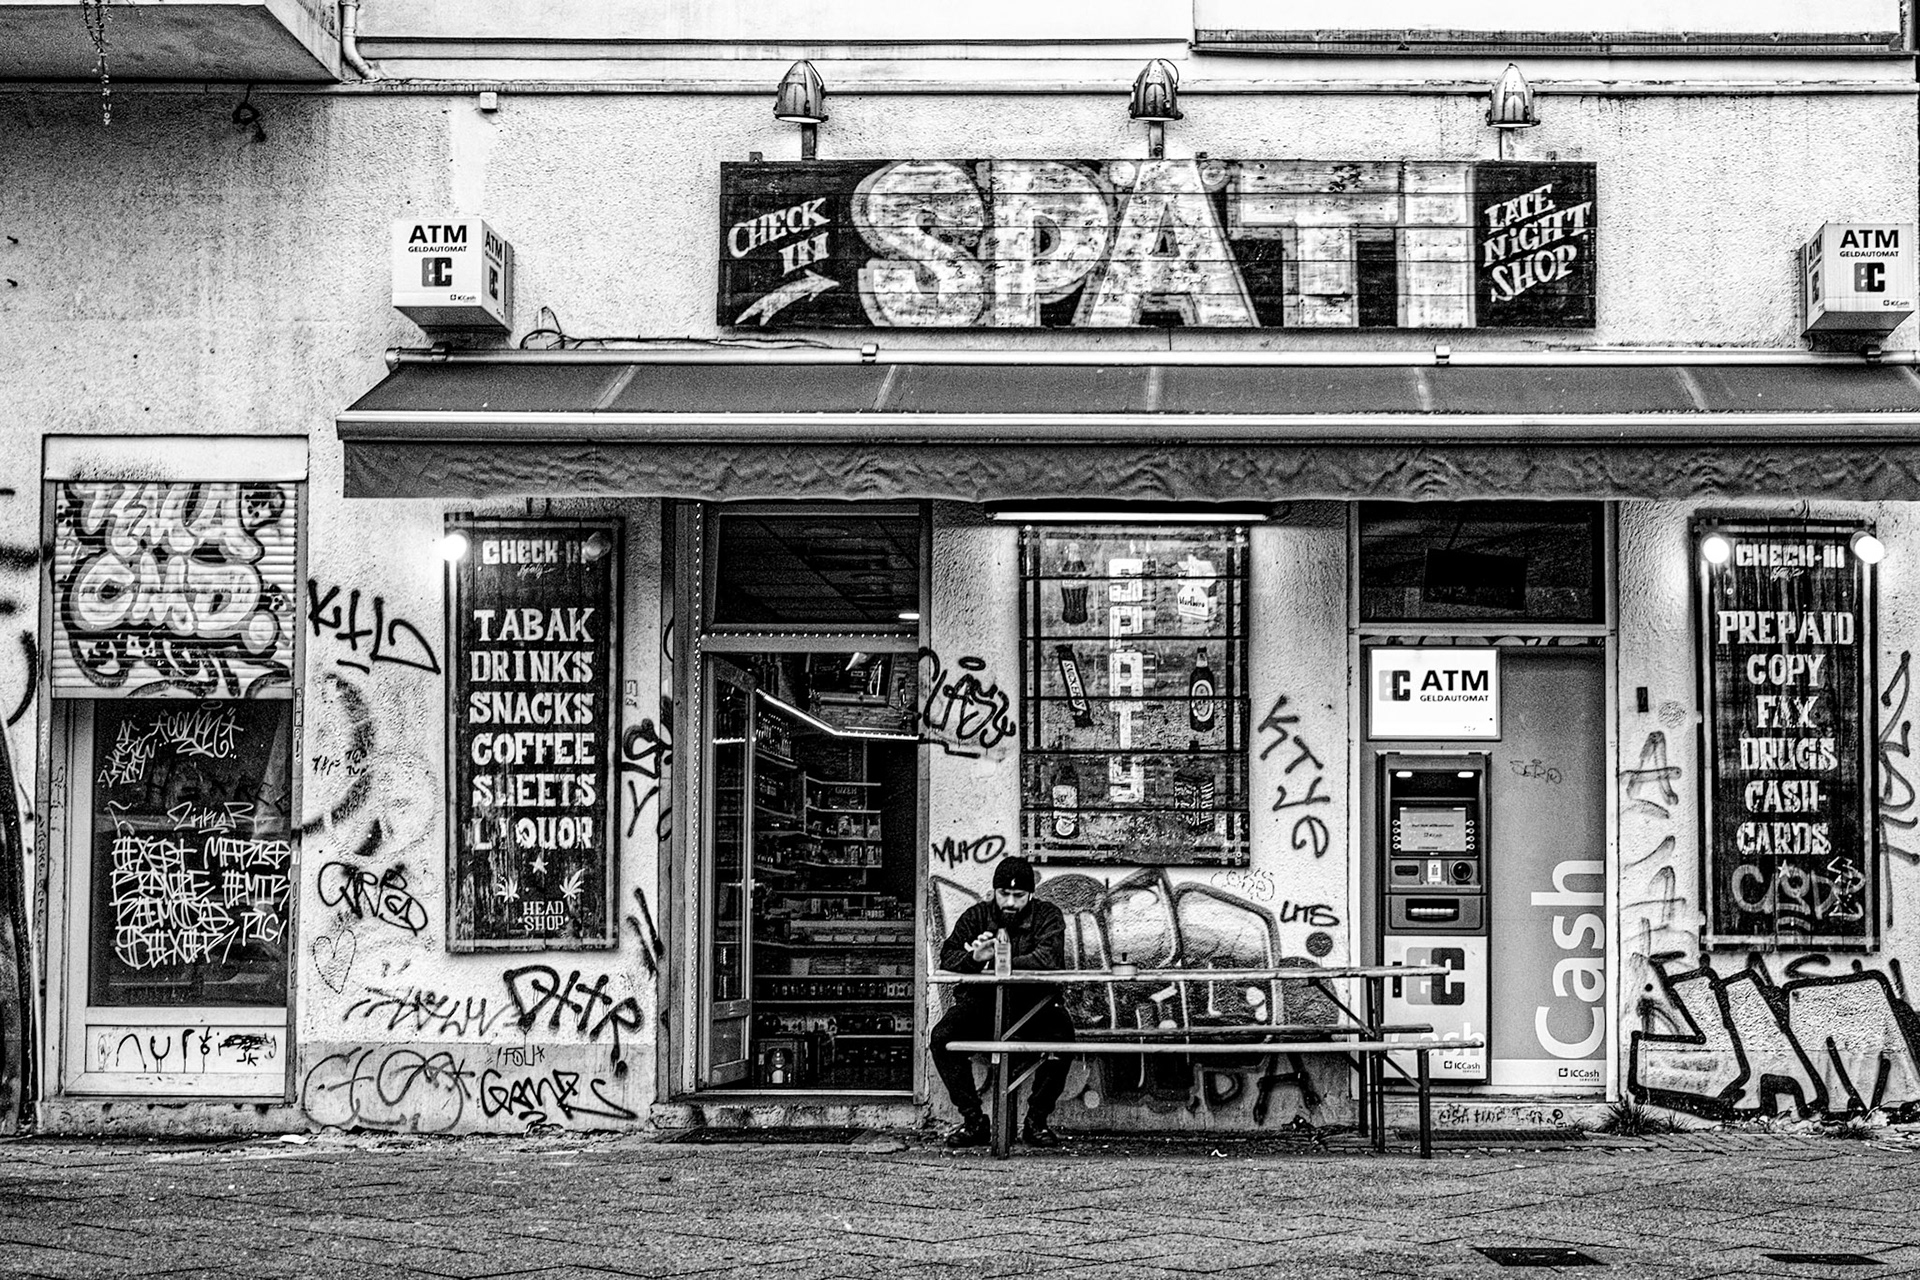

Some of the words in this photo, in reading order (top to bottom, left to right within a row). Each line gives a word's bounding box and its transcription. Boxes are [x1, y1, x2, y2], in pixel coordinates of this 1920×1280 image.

[1484, 183, 1554, 235] LATE
[408, 224, 467, 243] ATM
[727, 198, 831, 258] CHECK
[1839, 229, 1899, 248] ATM
[408, 245, 467, 253] GELDAUTOMAT
[779, 231, 829, 277] IN
[1839, 250, 1899, 258] GELDAUTOMAT
[1490, 244, 1577, 303] SHOP
[473, 607, 595, 642] TABAK
[1717, 610, 1855, 645] PREPAID
[469, 650, 595, 683] DRINKS
[1420, 670, 1489, 691] ATM
[1747, 653, 1826, 687] COPY
[469, 691, 595, 724] SNACKS
[1420, 694, 1489, 702] GELDAUTOMAT
[1756, 695, 1820, 729] FAX
[471, 732, 596, 766] COFFEE
[1739, 737, 1839, 770] DRUGS
[1736, 822, 1832, 855] CARDS
[523, 900, 565, 915] HEAD
[524, 915, 565, 931] SHOP
[1531, 859, 1605, 1060] Cash
[1455, 1061, 1481, 1070] ICCash
[1570, 1069, 1600, 1078] ICCash
